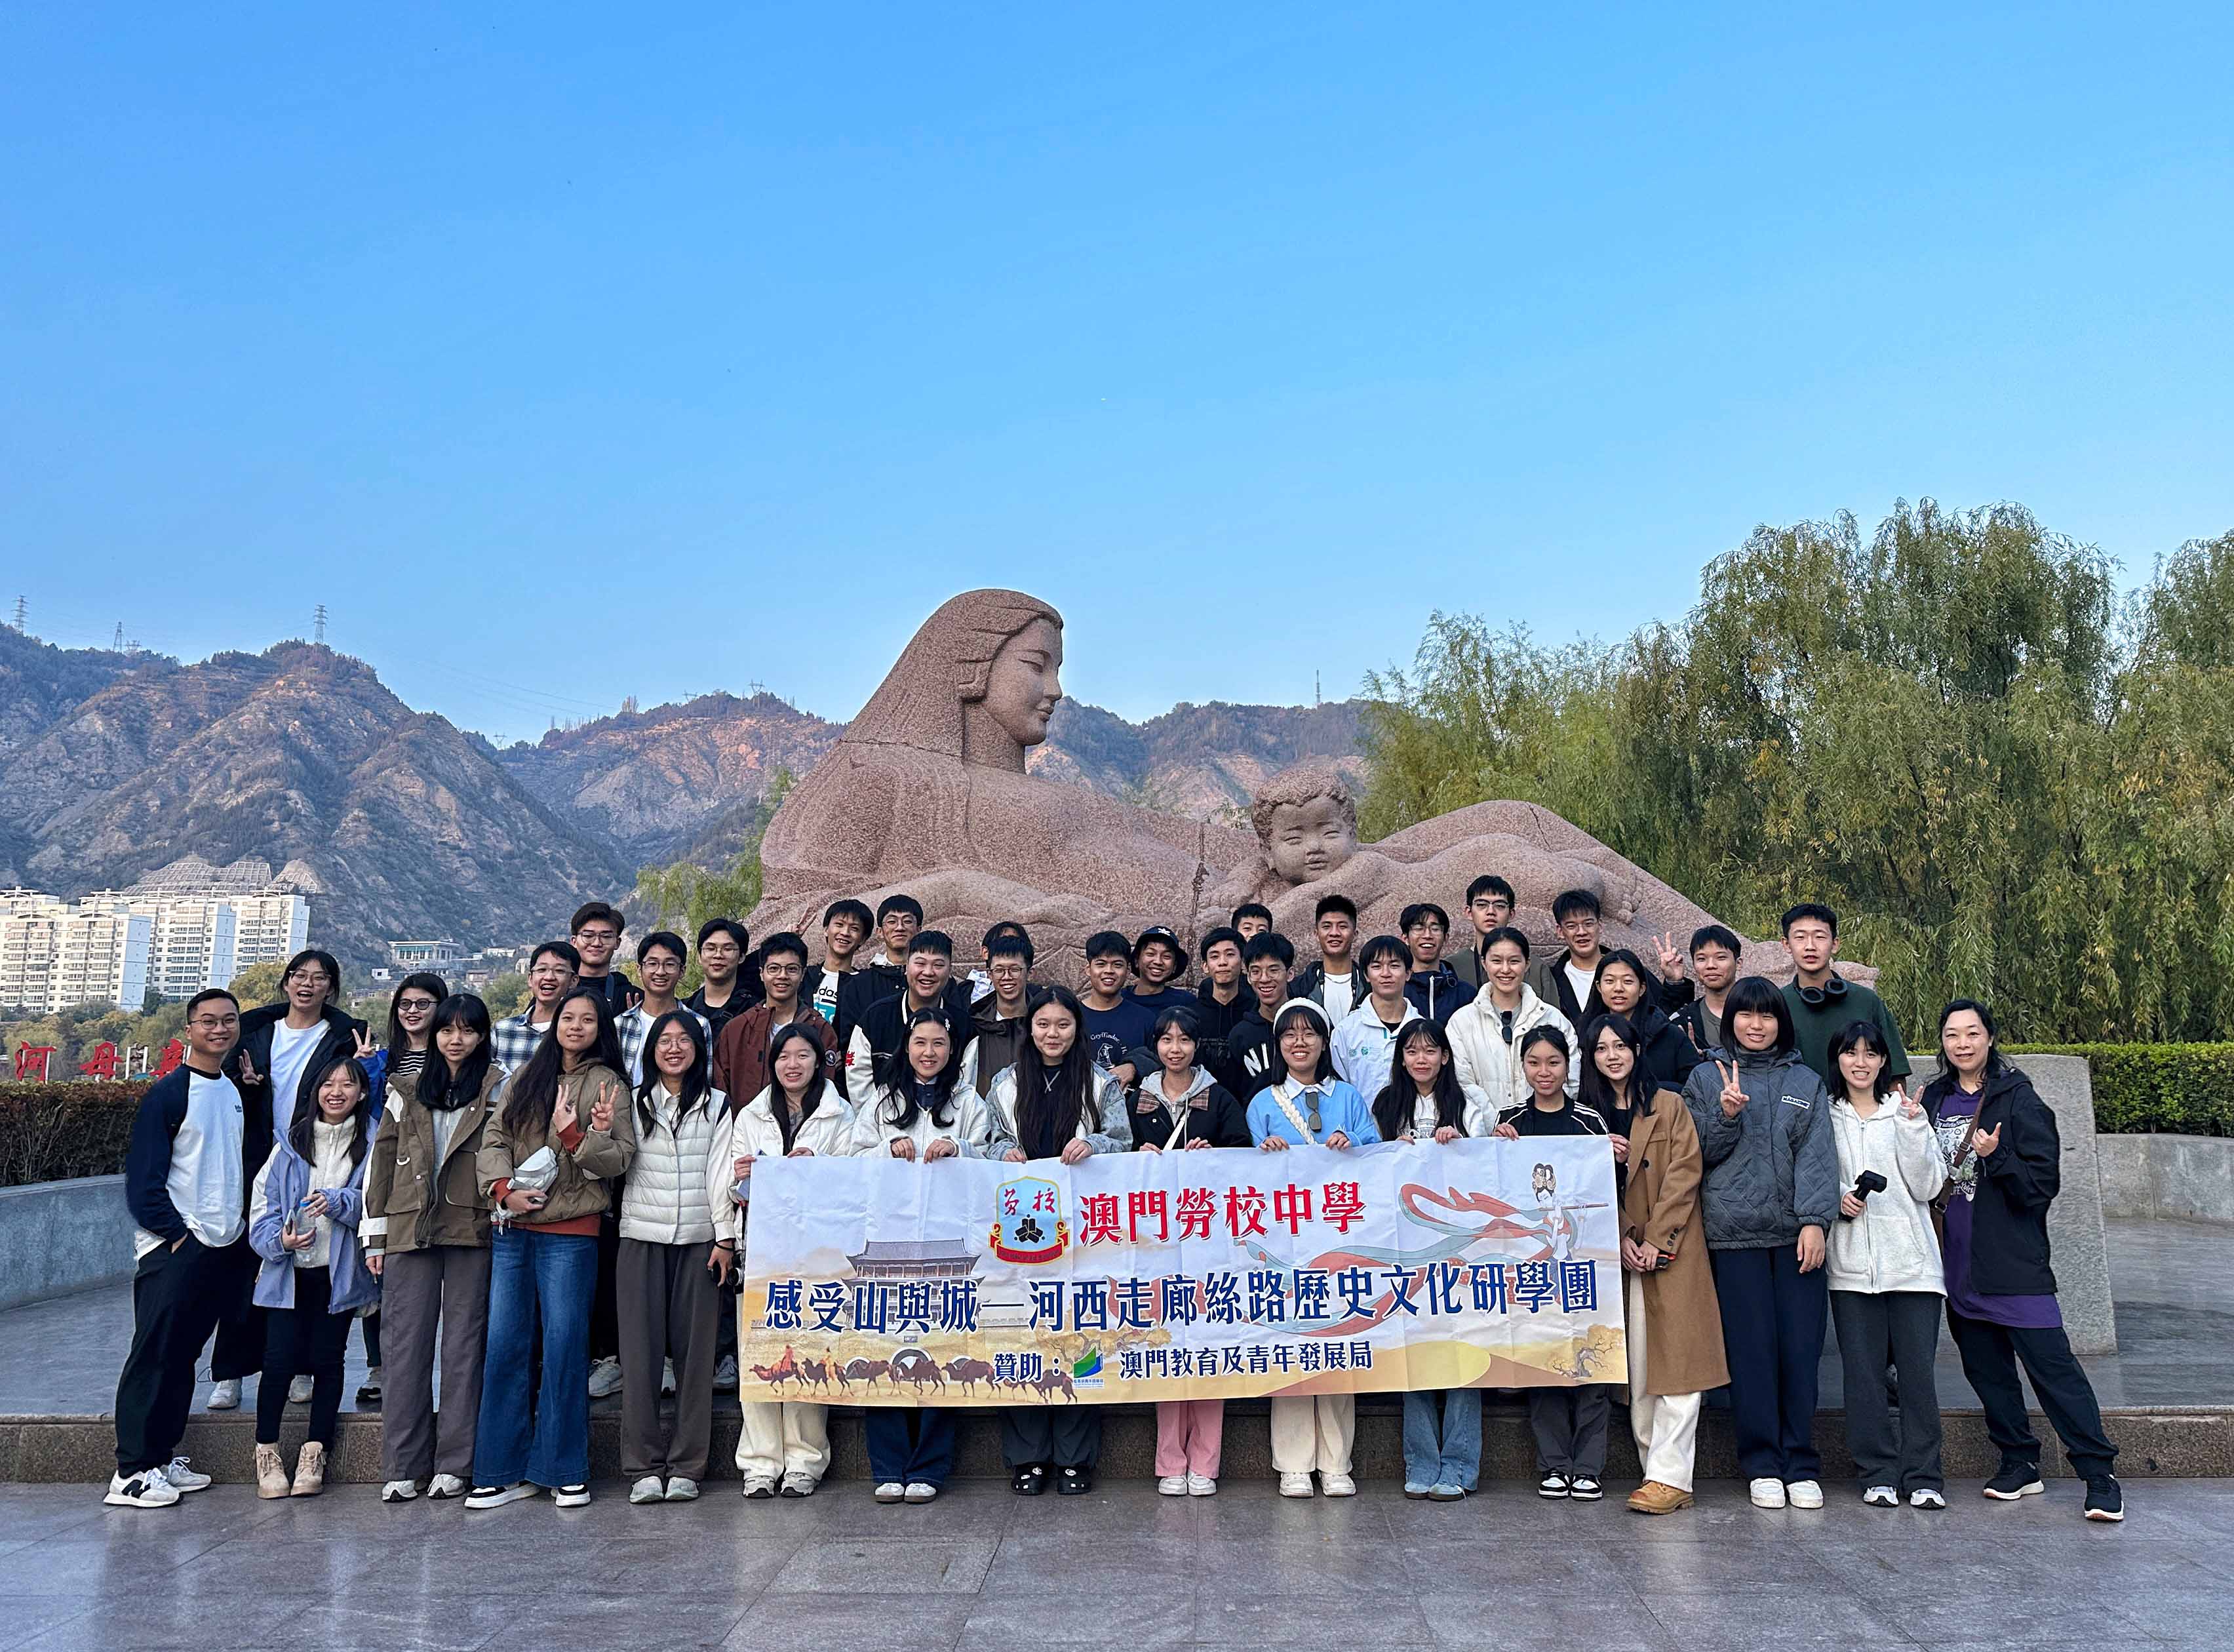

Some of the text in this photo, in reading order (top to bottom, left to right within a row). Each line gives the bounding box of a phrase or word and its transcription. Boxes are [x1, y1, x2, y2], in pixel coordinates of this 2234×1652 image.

[817, 986, 838, 998] das
[1244, 1043, 1270, 1077] NI
[1080, 1182, 1363, 1244] 澳門勞校中學
[1120, 1341, 1371, 1379] 澳門教育及青年發展局
